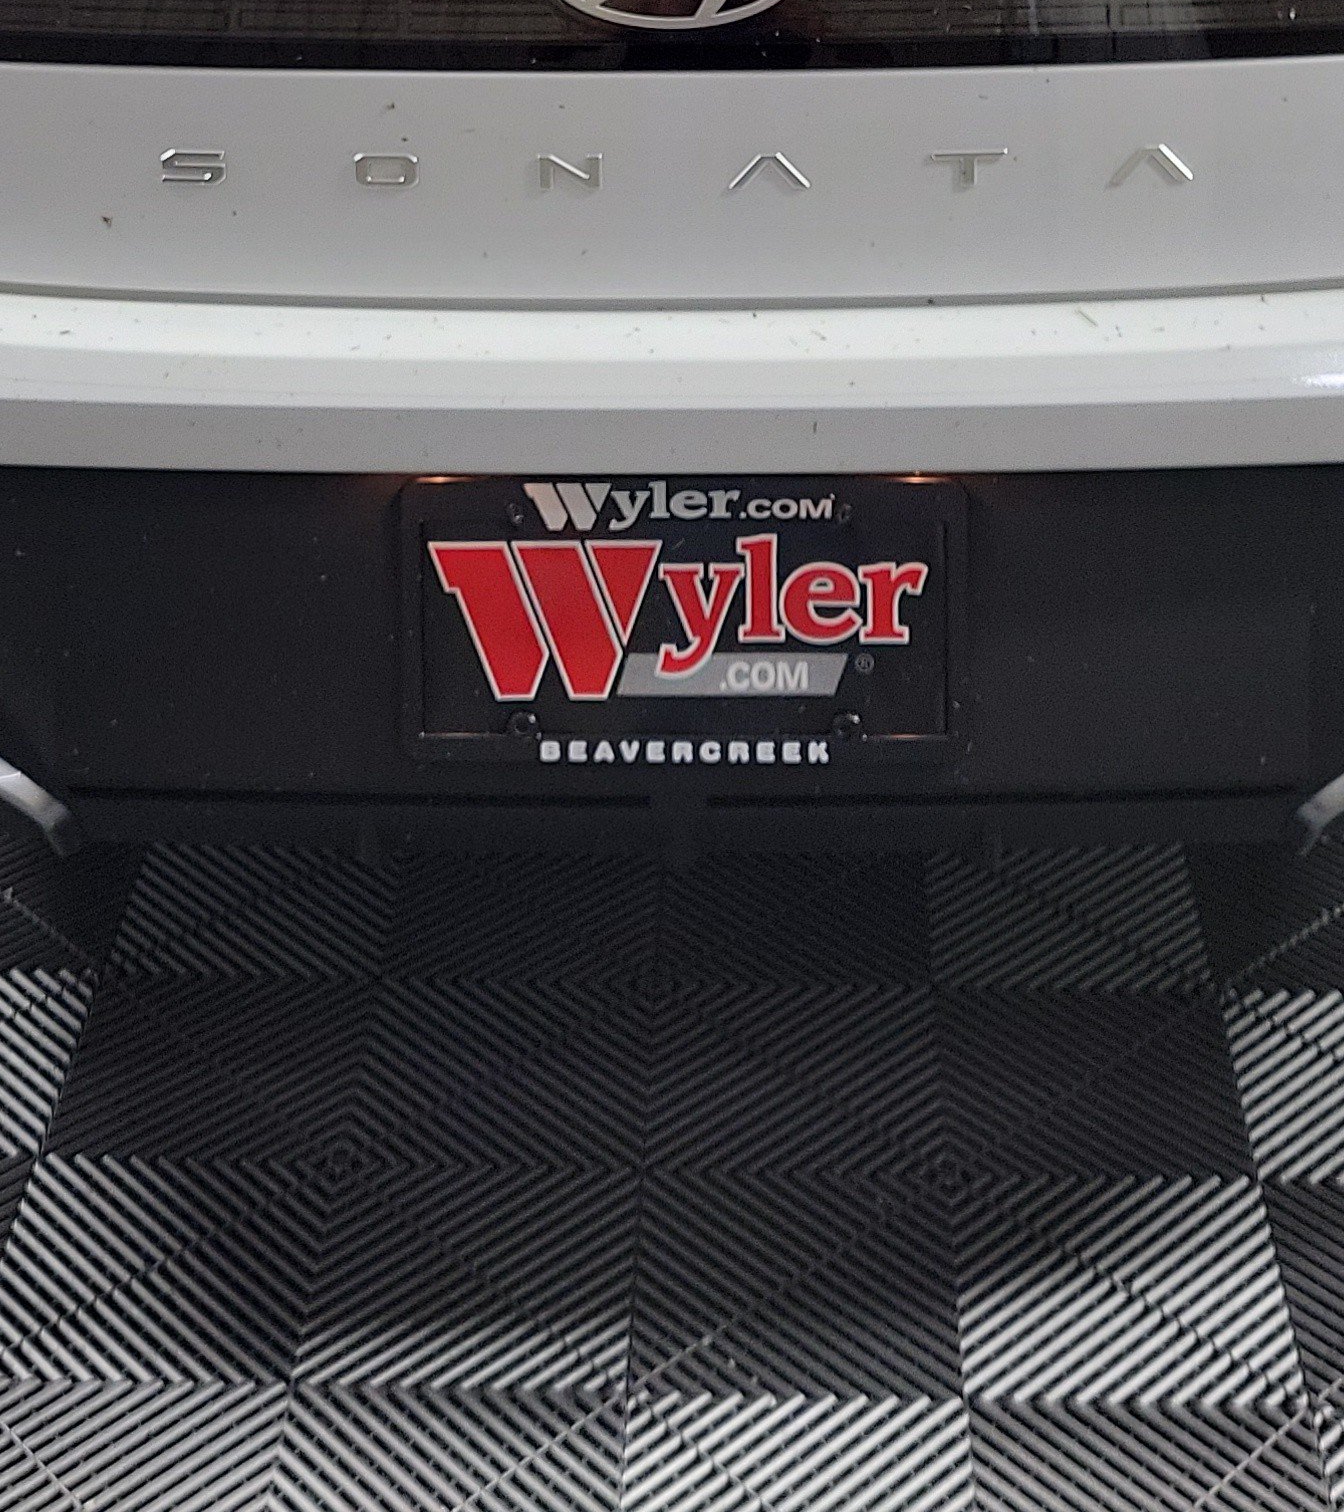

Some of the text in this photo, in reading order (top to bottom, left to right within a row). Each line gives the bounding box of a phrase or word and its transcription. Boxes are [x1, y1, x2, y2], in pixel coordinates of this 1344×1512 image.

[158, 142, 1196, 190] SONATA
[427, 533, 928, 702] Wyler
[539, 740, 829, 763] BEAVERCREEK
